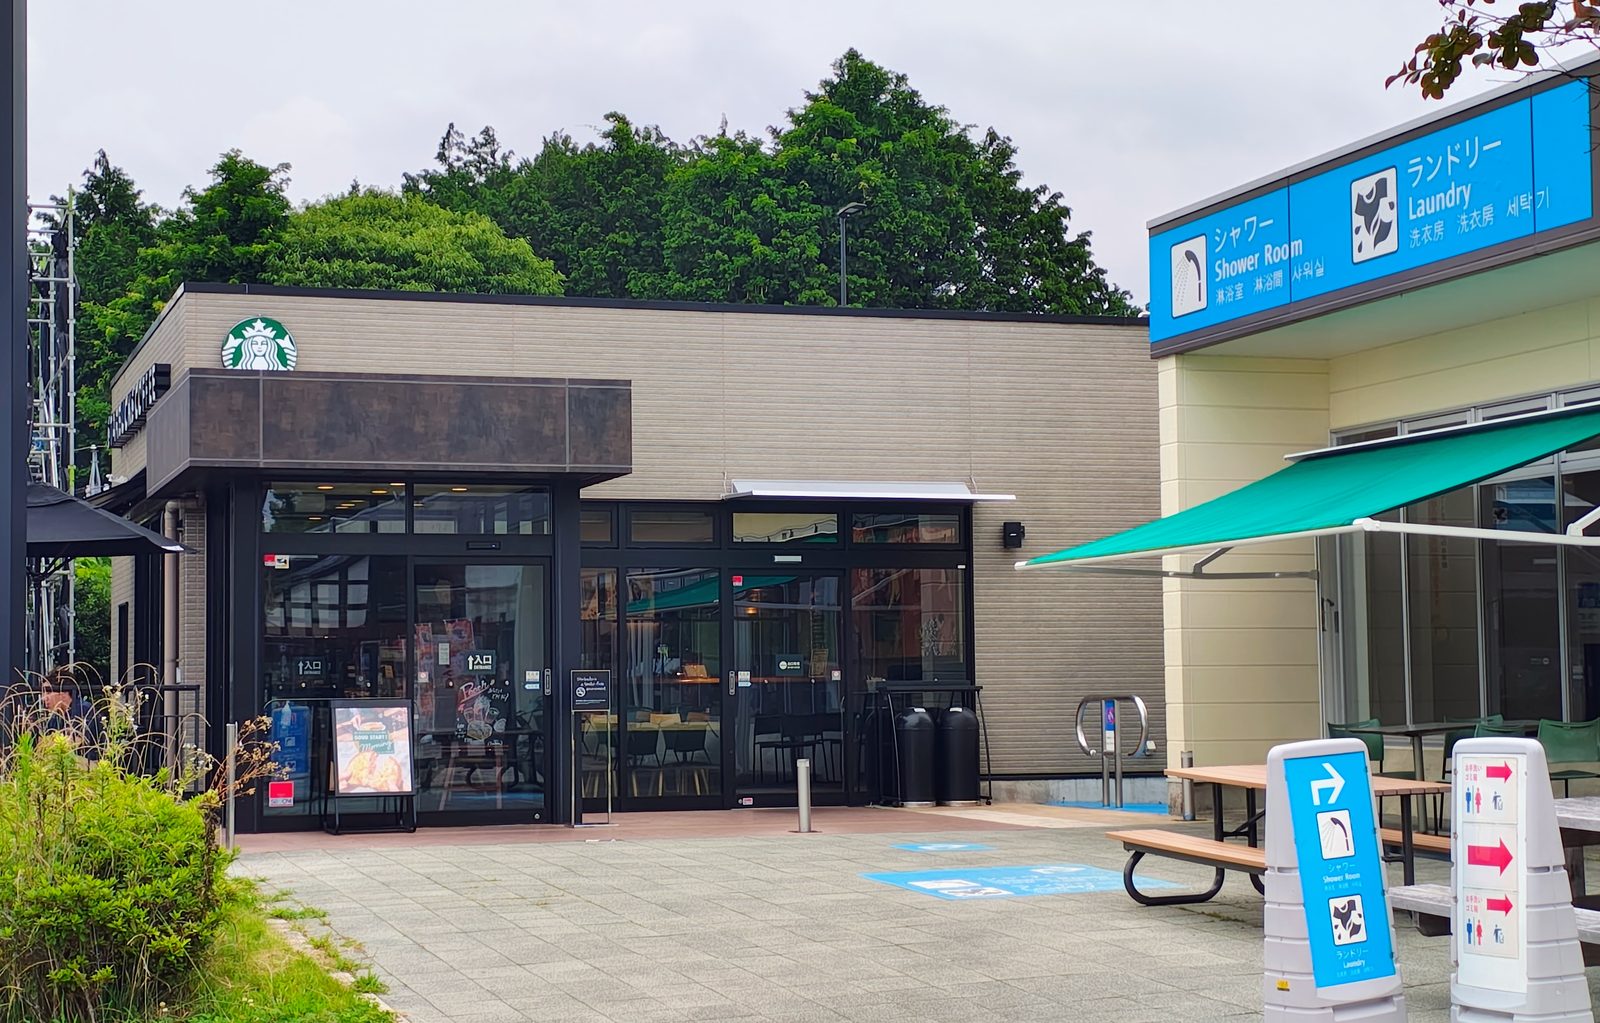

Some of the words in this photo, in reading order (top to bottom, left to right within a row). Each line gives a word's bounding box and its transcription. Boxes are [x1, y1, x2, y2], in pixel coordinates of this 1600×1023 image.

[1408, 136, 1502, 188] ランドリー
[1408, 181, 1472, 220] Laundry
[1410, 220, 1445, 249] 洗衣房
[1457, 203, 1494, 235] 洗衣房
[1506, 186, 1550, 217] 세탁기
[1214, 215, 1274, 253] シャワー
[1215, 253, 1260, 282] Shower
[1264, 239, 1303, 266] Room
[1216, 282, 1244, 305] 淋浴室
[1291, 256, 1324, 282] 샤워실
[304, 660, 321, 670] 入口
[473, 654, 492, 664] 入口
[1322, 874, 1344, 884] Shower
[1345, 872, 1361, 881] Room
[1328, 862, 1356, 873] シャワー
[1336, 948, 1369, 960] ランドリー
[1343, 958, 1366, 970] Laundry
